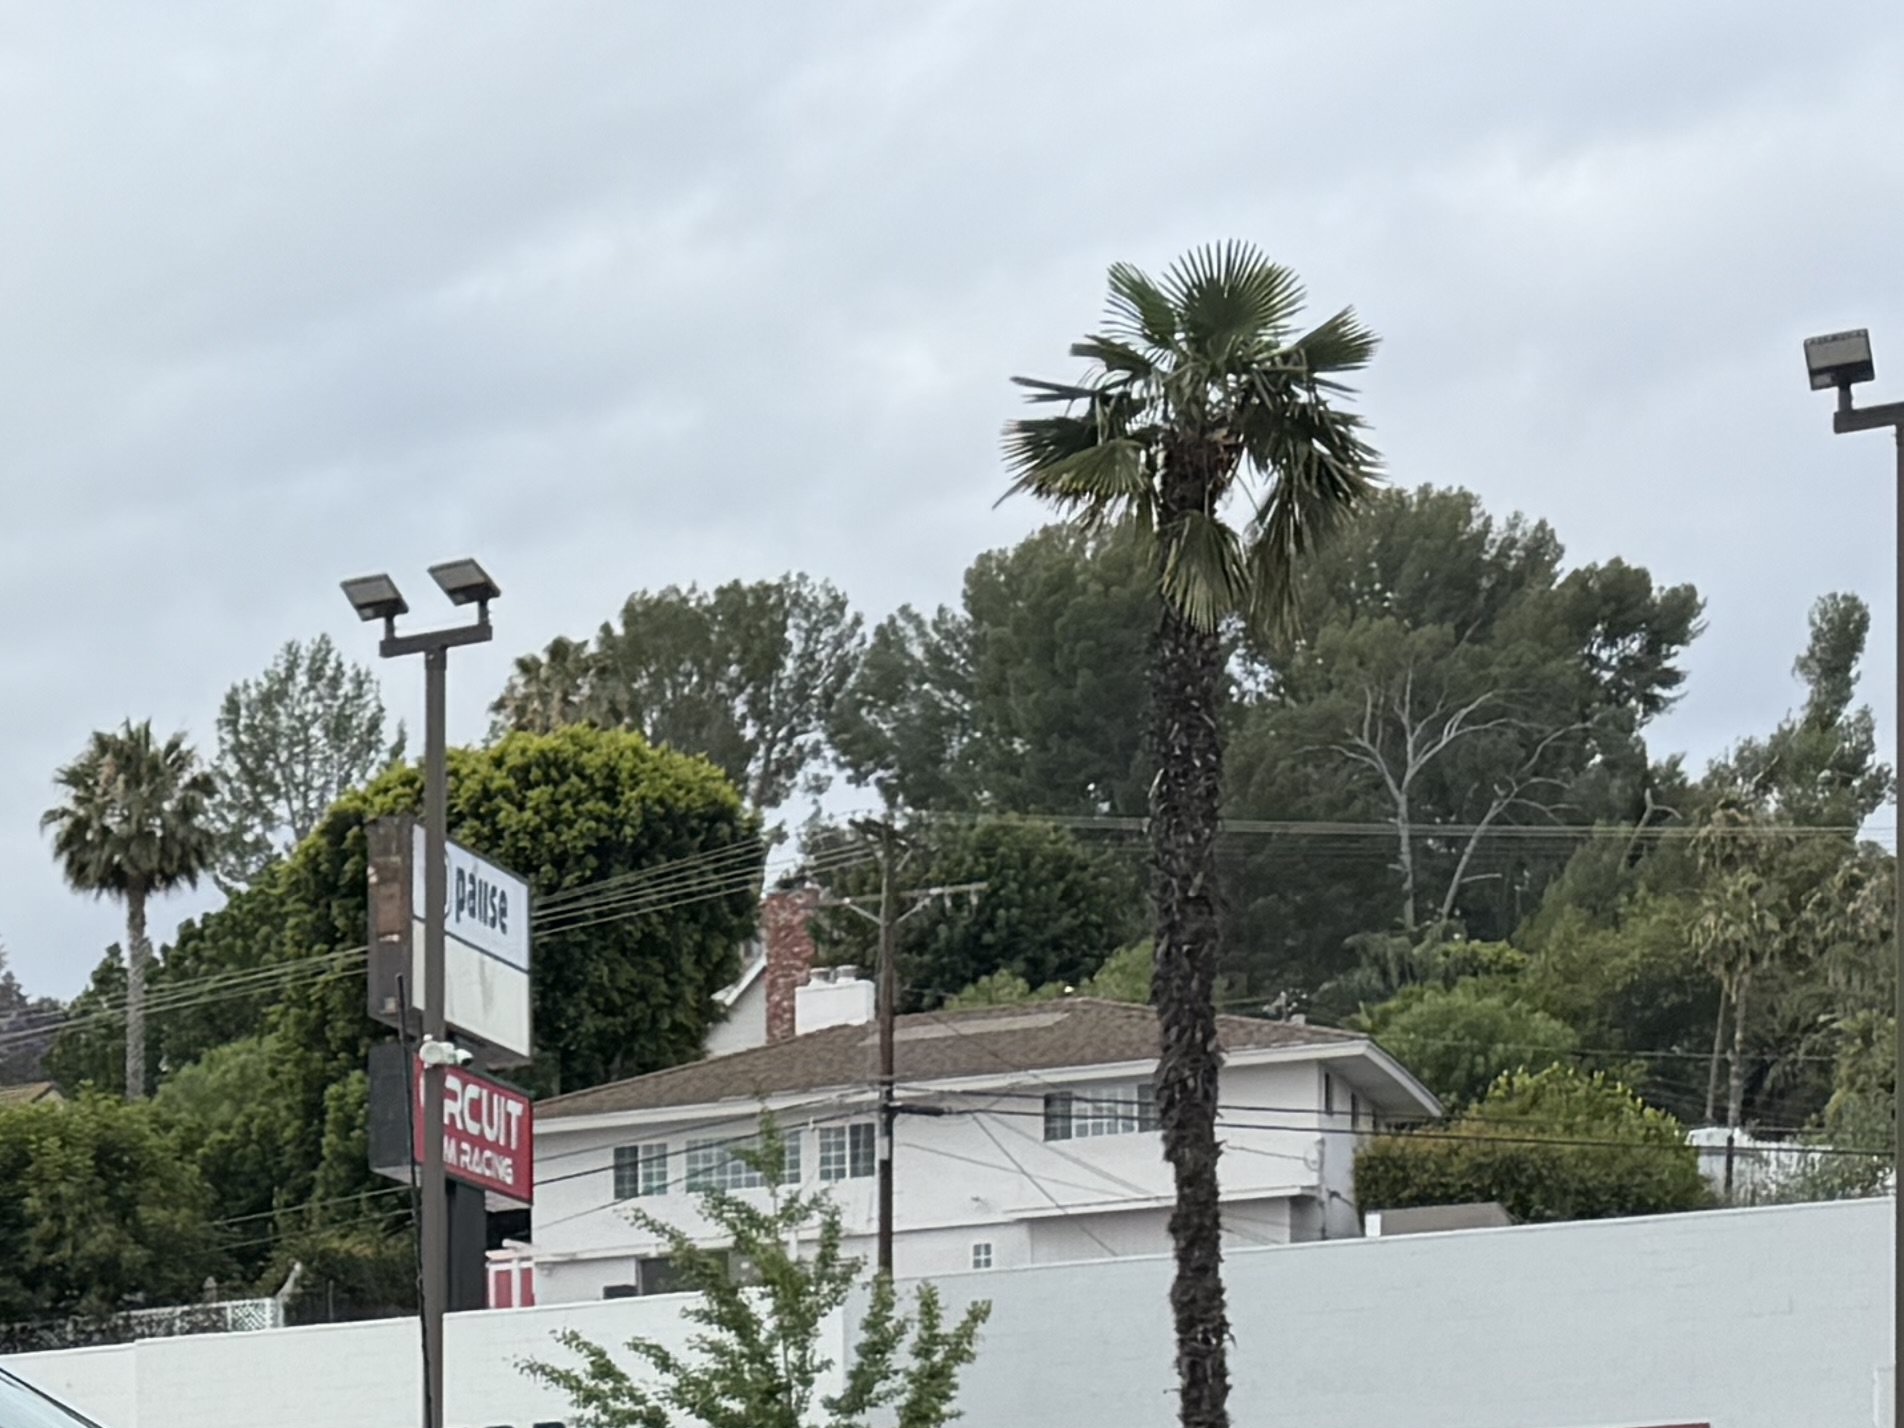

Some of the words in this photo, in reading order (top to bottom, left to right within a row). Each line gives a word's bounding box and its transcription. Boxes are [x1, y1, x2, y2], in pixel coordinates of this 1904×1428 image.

[455, 866, 508, 935] pause
[418, 1068, 523, 1150] RCUIT
[459, 1141, 514, 1186] RACING
